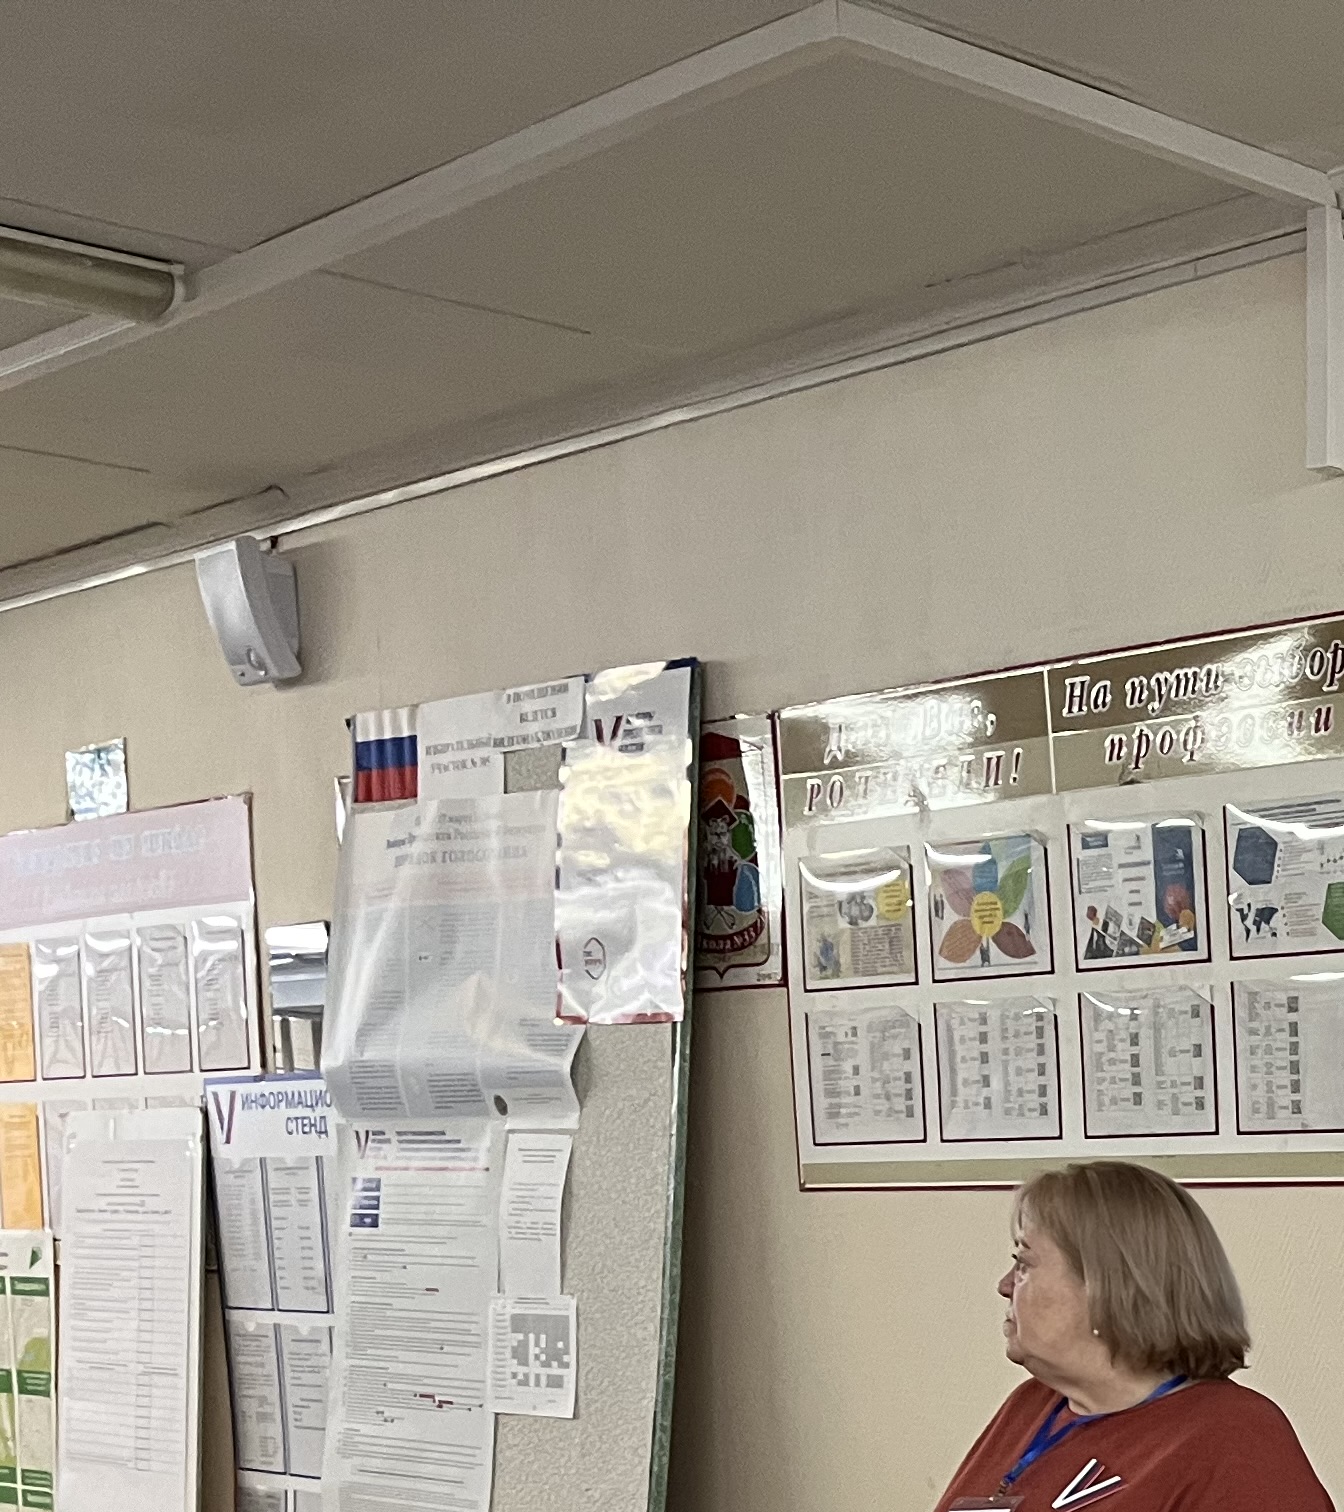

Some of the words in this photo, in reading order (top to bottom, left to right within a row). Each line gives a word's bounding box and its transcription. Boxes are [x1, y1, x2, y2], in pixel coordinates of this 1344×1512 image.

[1063, 676, 1112, 717] На
[1125, 663, 1225, 715] пути
[286, 1116, 329, 1139] СТЕНД
